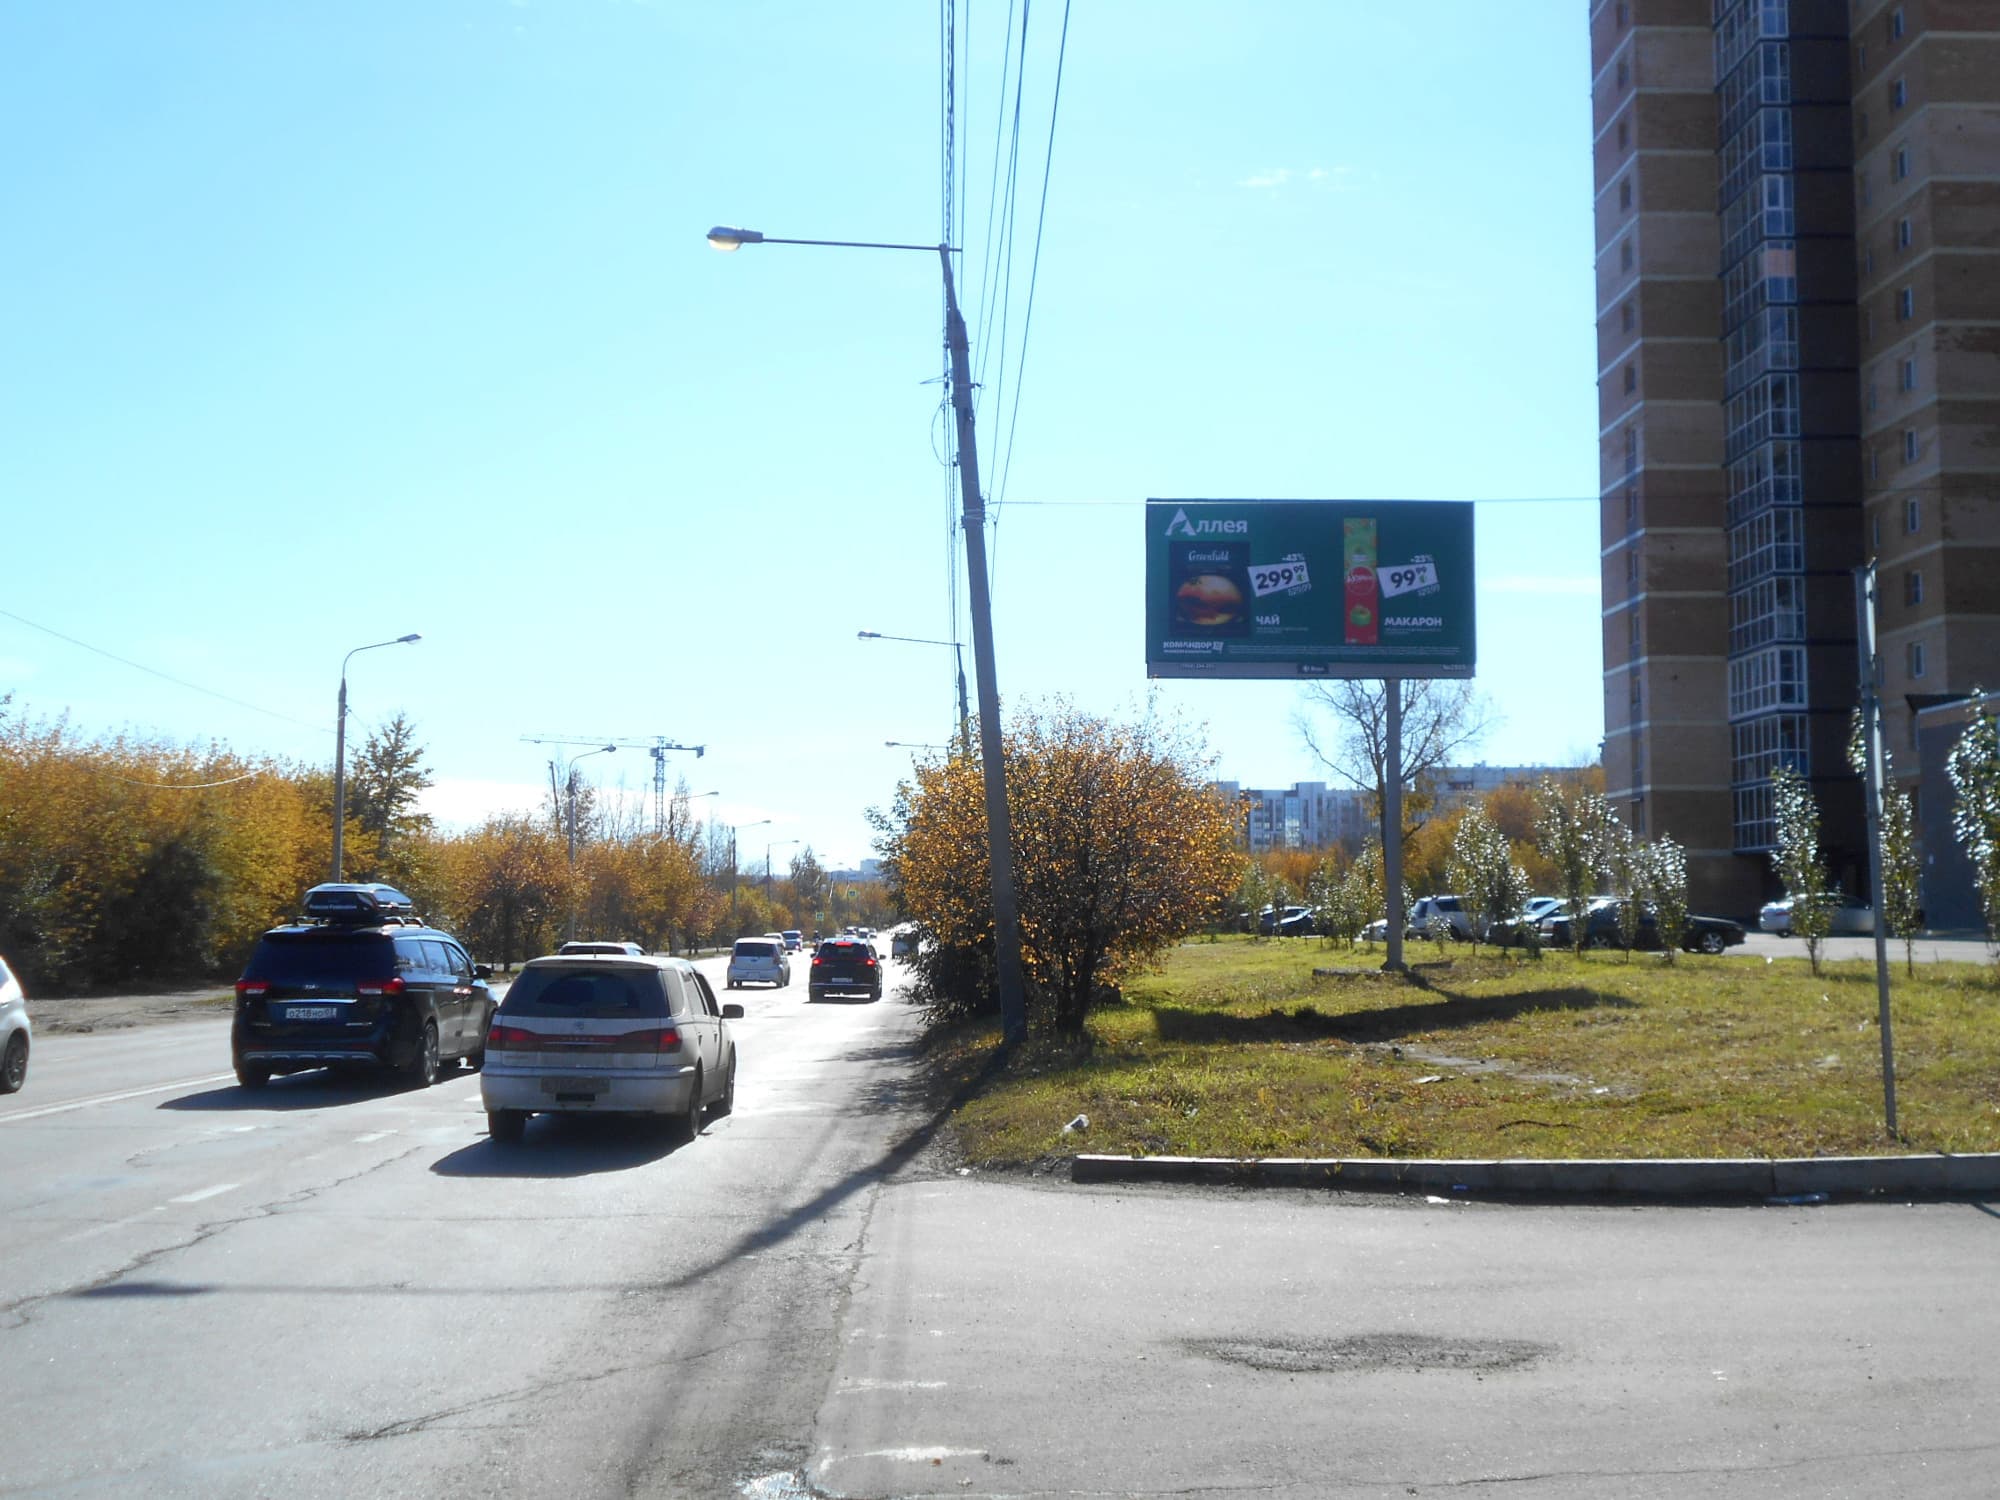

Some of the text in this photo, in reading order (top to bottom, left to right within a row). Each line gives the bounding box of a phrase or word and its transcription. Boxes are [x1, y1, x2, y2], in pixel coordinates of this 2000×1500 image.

[1165, 508, 1248, 536] Аллея
[1256, 614, 1280, 625] ЧАЙ
[1384, 617, 1442, 626] МАКАРОН
[1163, 641, 1212, 649] КОМАНДОР
